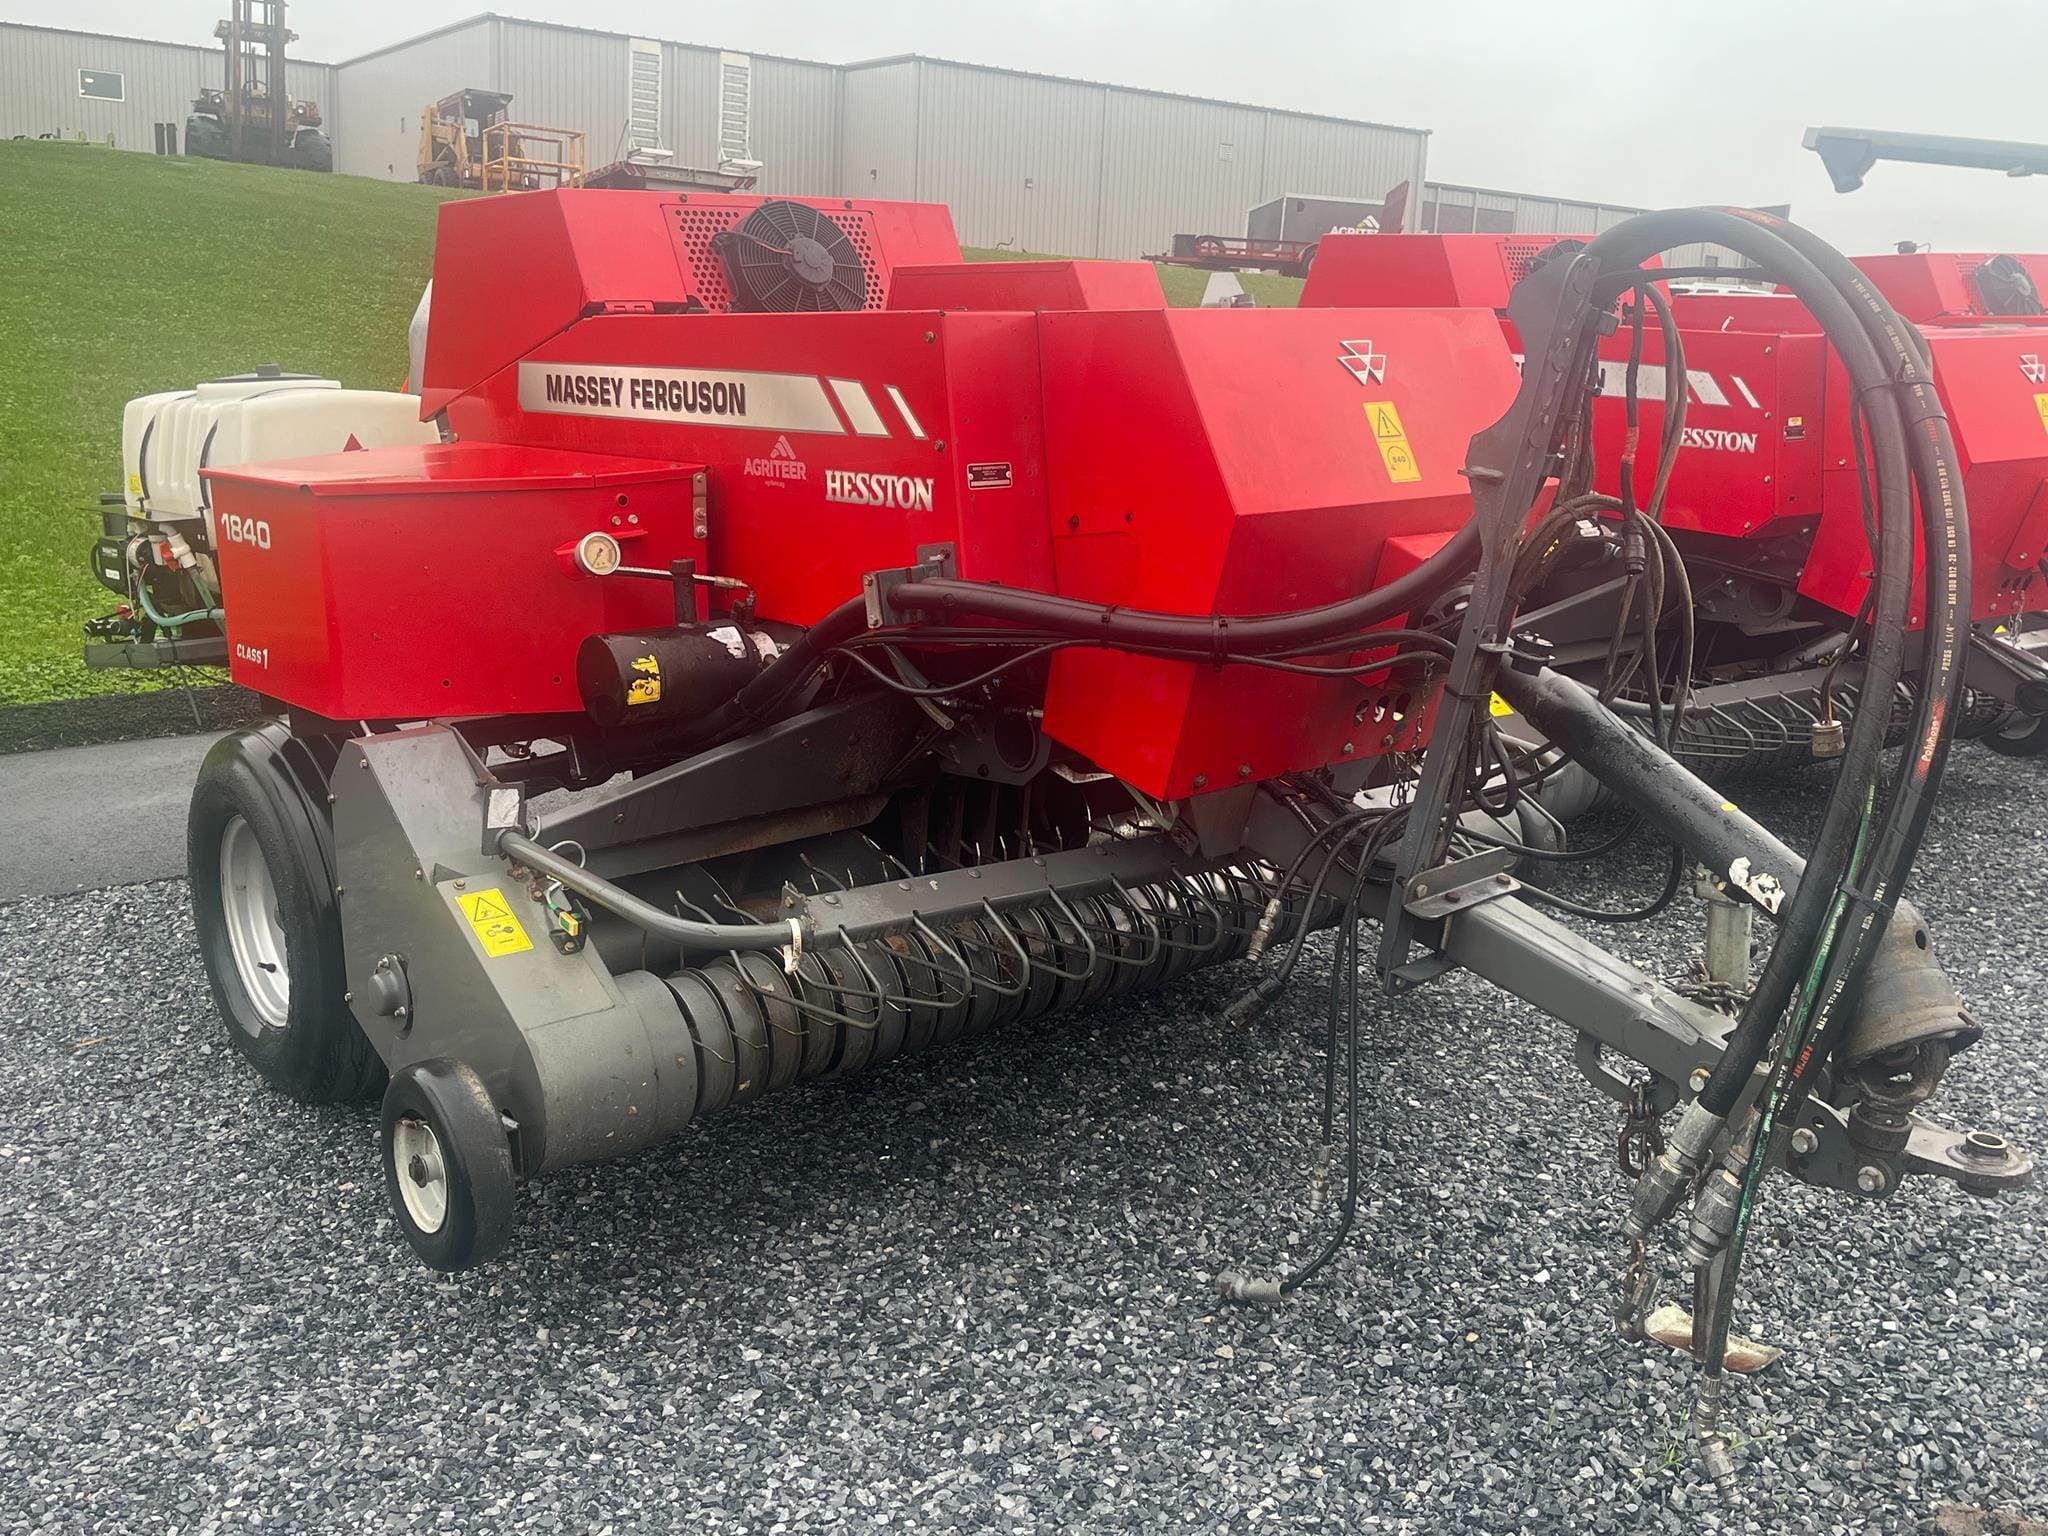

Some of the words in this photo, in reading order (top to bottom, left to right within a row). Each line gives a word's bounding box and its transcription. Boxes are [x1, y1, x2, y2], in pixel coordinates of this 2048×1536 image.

[546, 374, 624, 409] MASSEY
[630, 378, 747, 417] FERGUSON
[1680, 427, 1758, 453] ESSTON
[744, 458, 807, 481] AGRITEER
[825, 469, 935, 512] HESSTON
[221, 512, 271, 550] 1840
[236, 643, 262, 665] CLASS
[262, 648, 269, 670] 1
